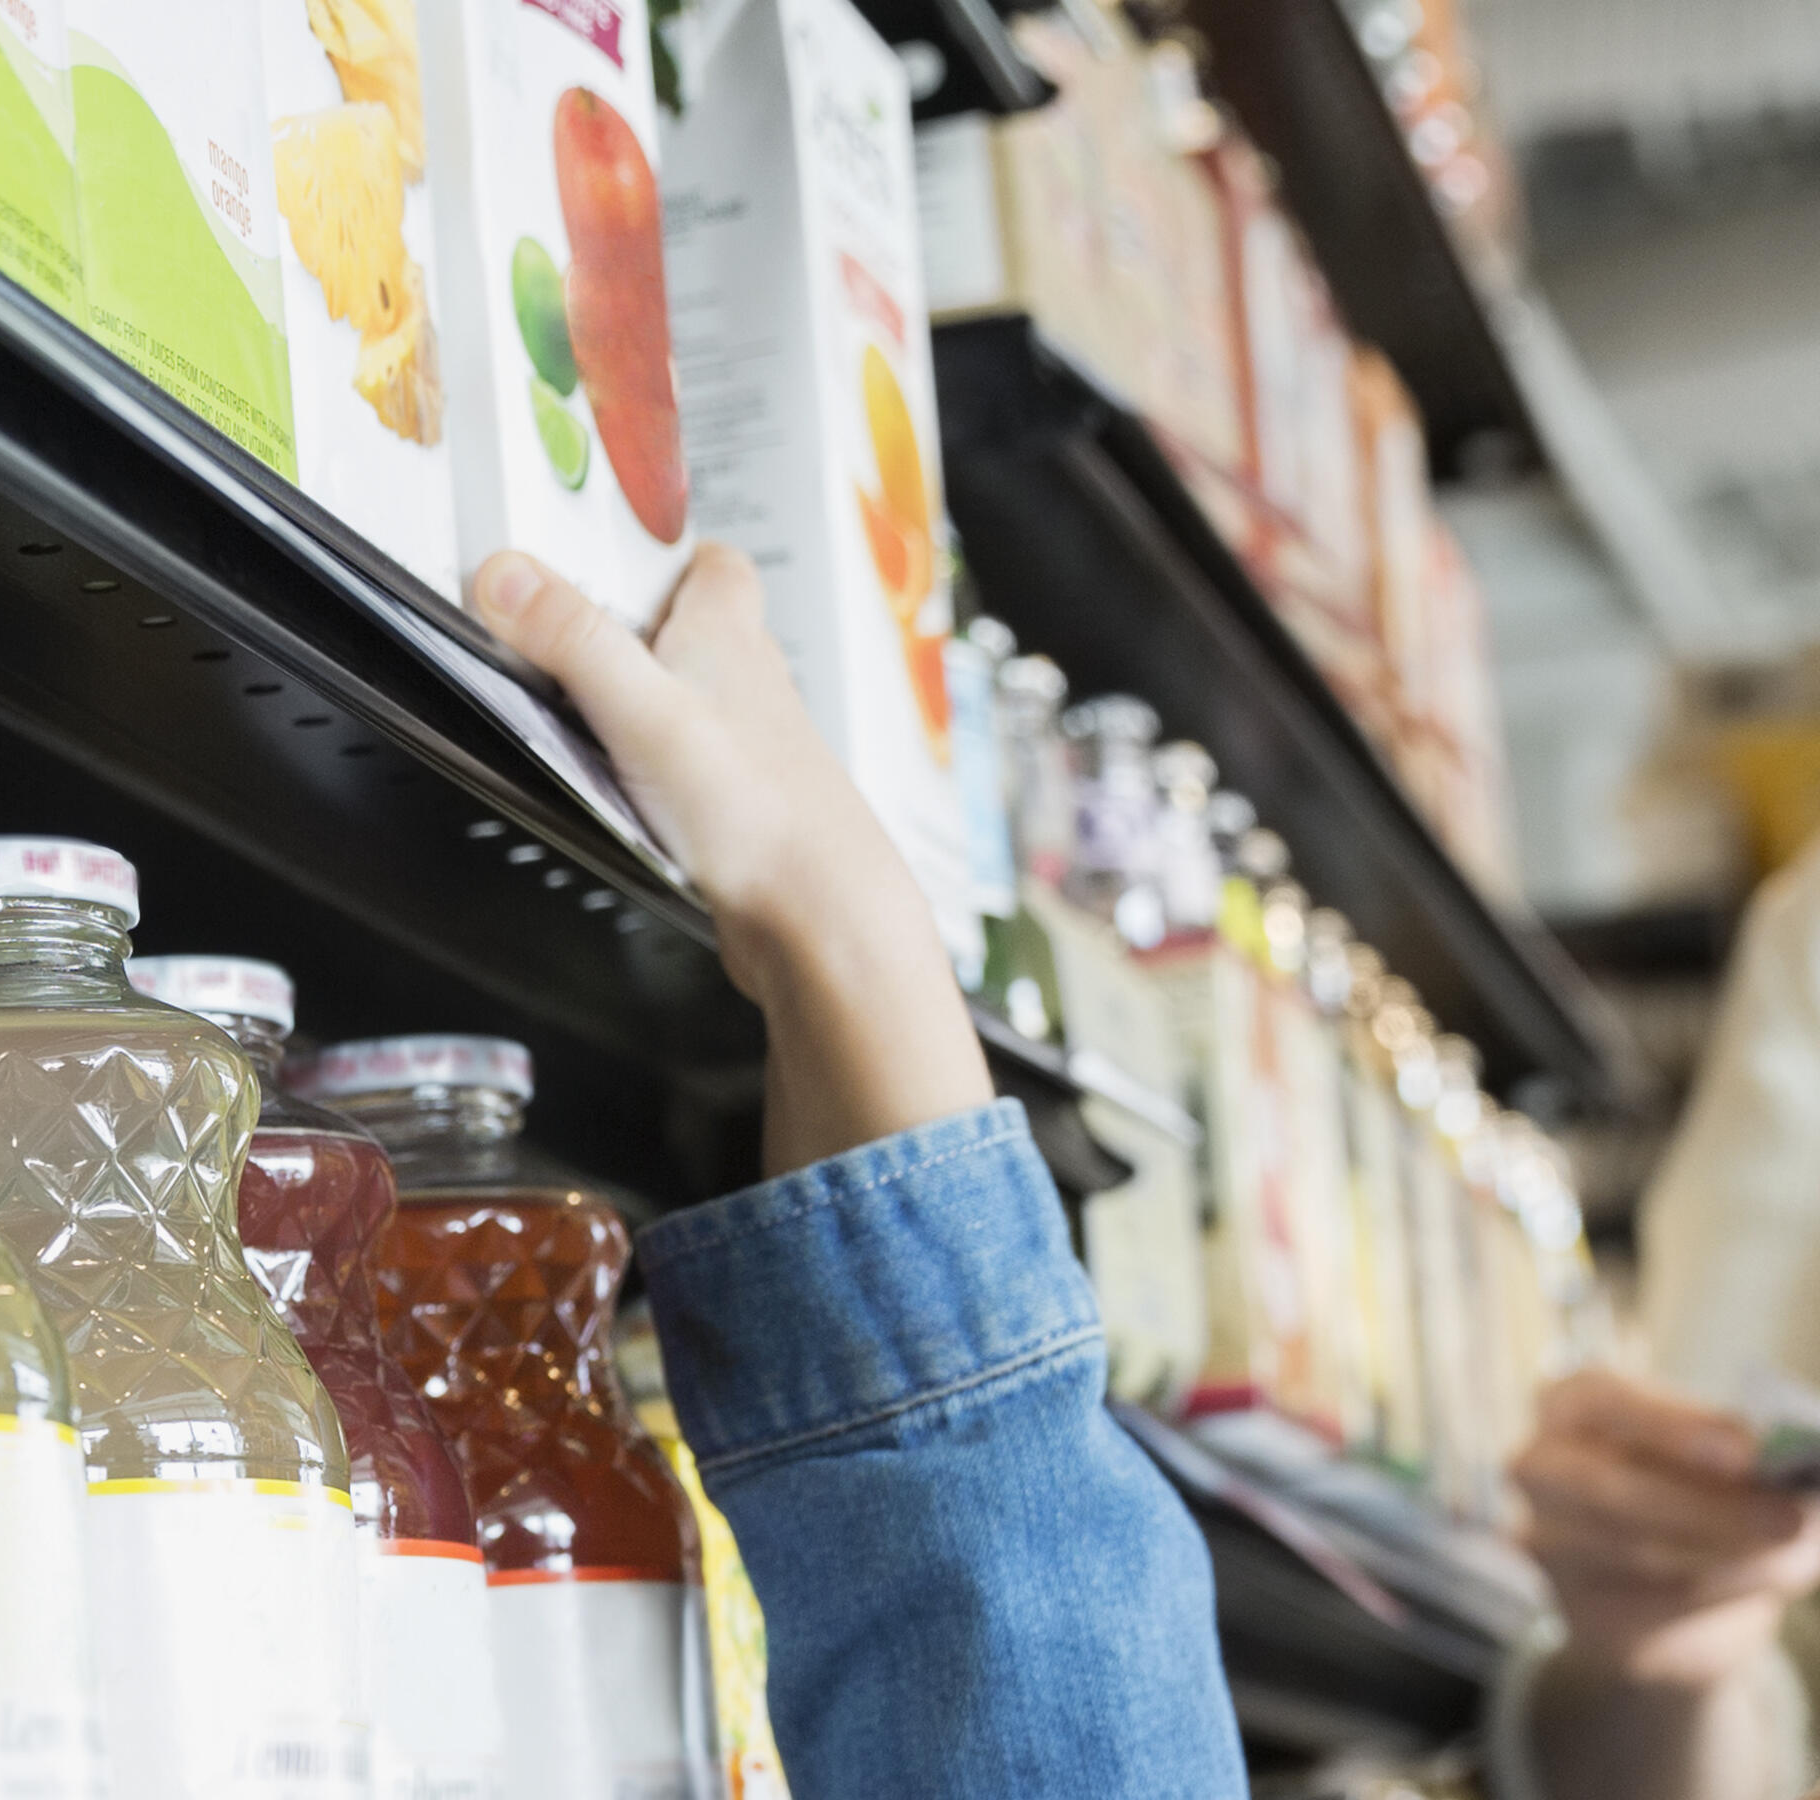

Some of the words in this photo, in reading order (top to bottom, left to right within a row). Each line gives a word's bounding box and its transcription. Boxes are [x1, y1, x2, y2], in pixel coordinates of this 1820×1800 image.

[207, 136, 249, 198] mango
[211, 179, 252, 237] orange
[123, 320, 148, 353] FRUIT
[149, 338, 176, 371] JUICES
[176, 354, 198, 387] FROM
[199, 369, 250, 423] CONCENTRATE
